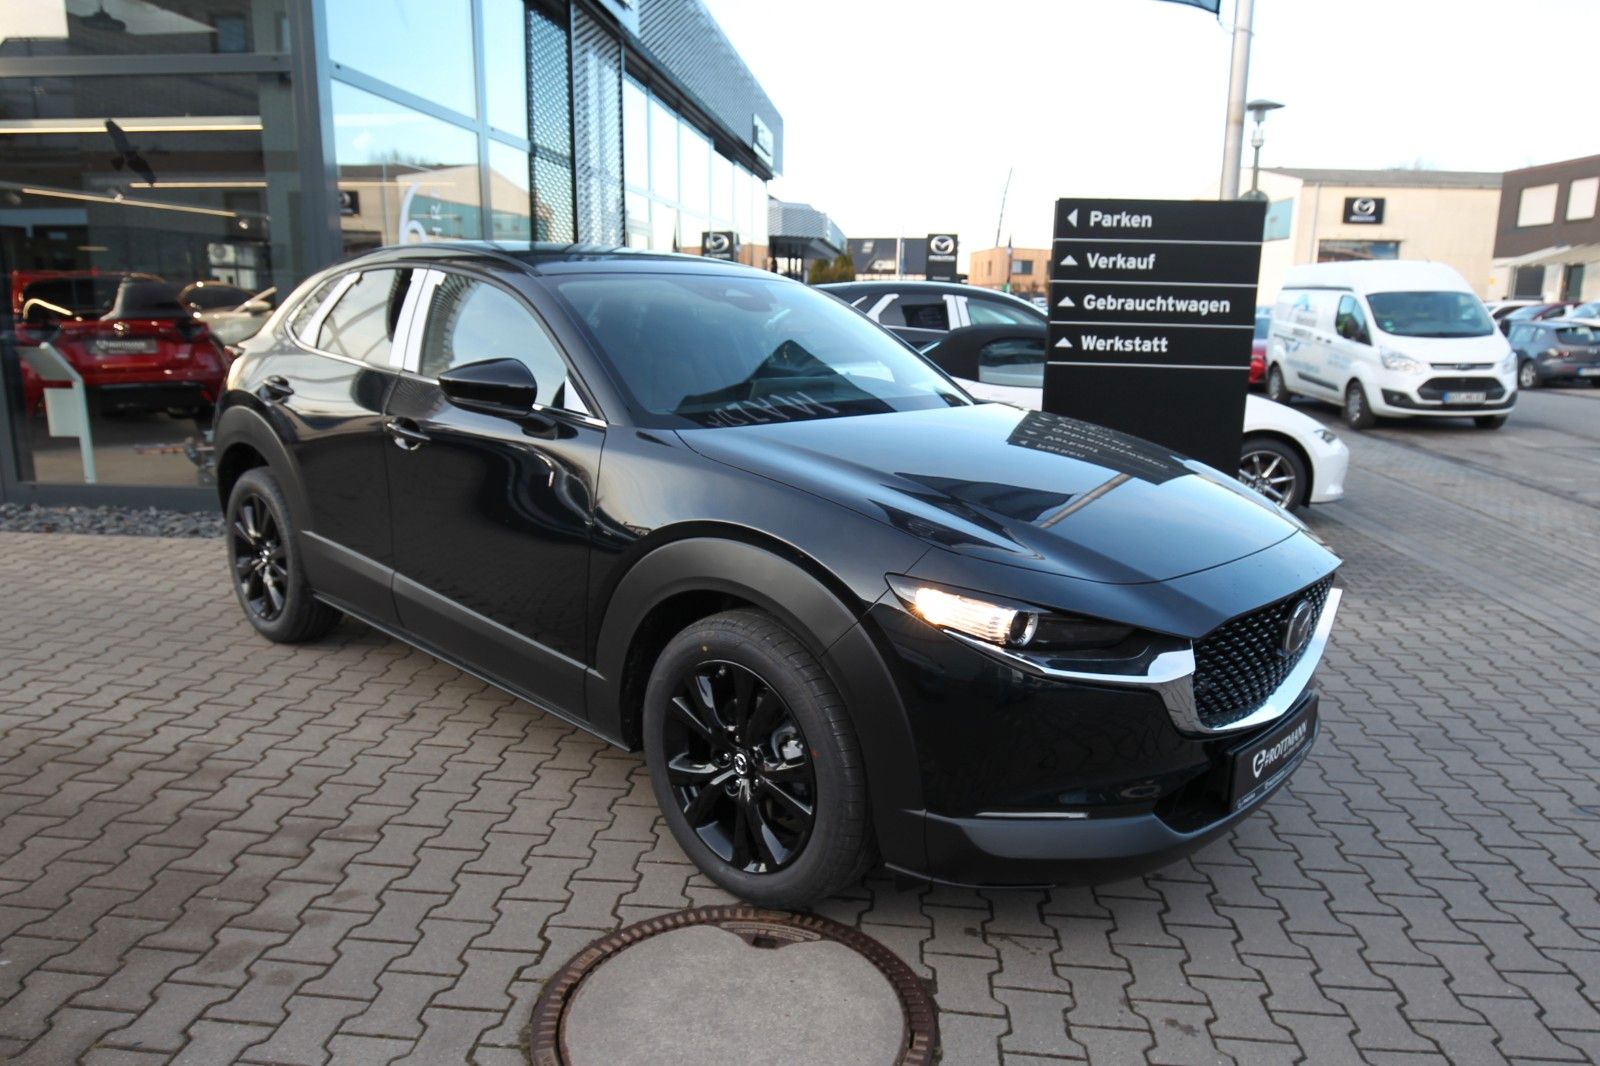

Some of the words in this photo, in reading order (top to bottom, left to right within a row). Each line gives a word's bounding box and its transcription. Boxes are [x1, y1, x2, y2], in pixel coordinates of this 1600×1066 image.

[1090, 211, 1152, 227] Parken
[1087, 253, 1155, 269] Verkauf
[1084, 294, 1230, 315] Gebrauchtwagen
[1081, 336, 1168, 352] Werkstatt
